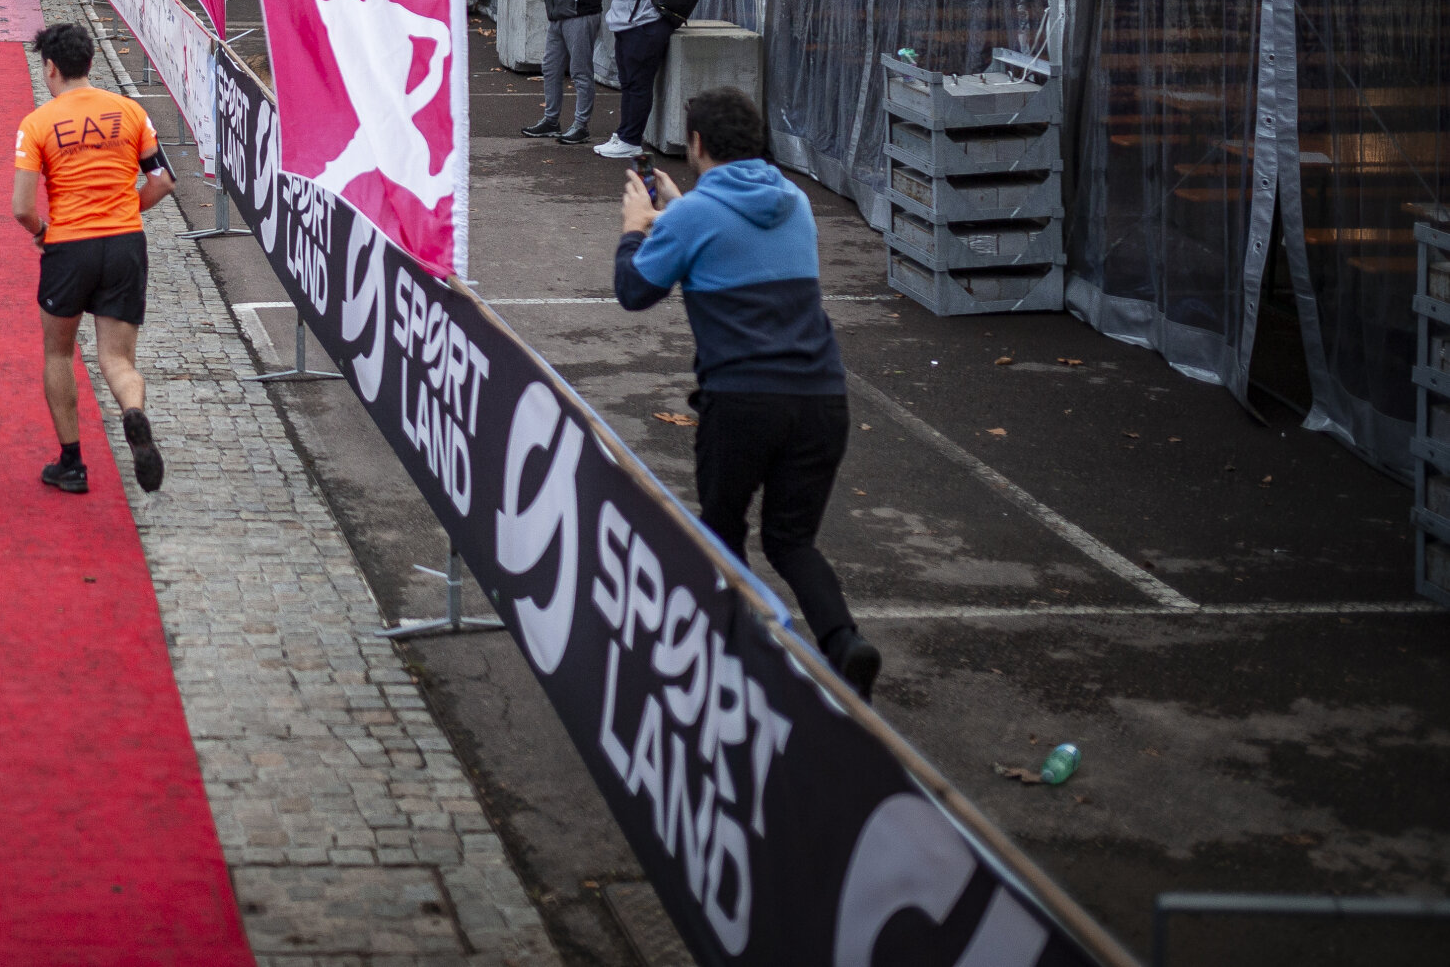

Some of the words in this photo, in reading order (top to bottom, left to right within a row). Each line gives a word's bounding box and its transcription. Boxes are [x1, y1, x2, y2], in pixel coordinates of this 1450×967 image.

[53, 111, 123, 149] EA7
[217, 64, 249, 146] SPORT
[222, 123, 248, 195] LAND
[286, 210, 329, 316] LAND
[393, 266, 489, 436] SPORT
[401, 356, 471, 518] LAND
[592, 500, 794, 837] SPORT
[600, 640, 752, 957] LAND
